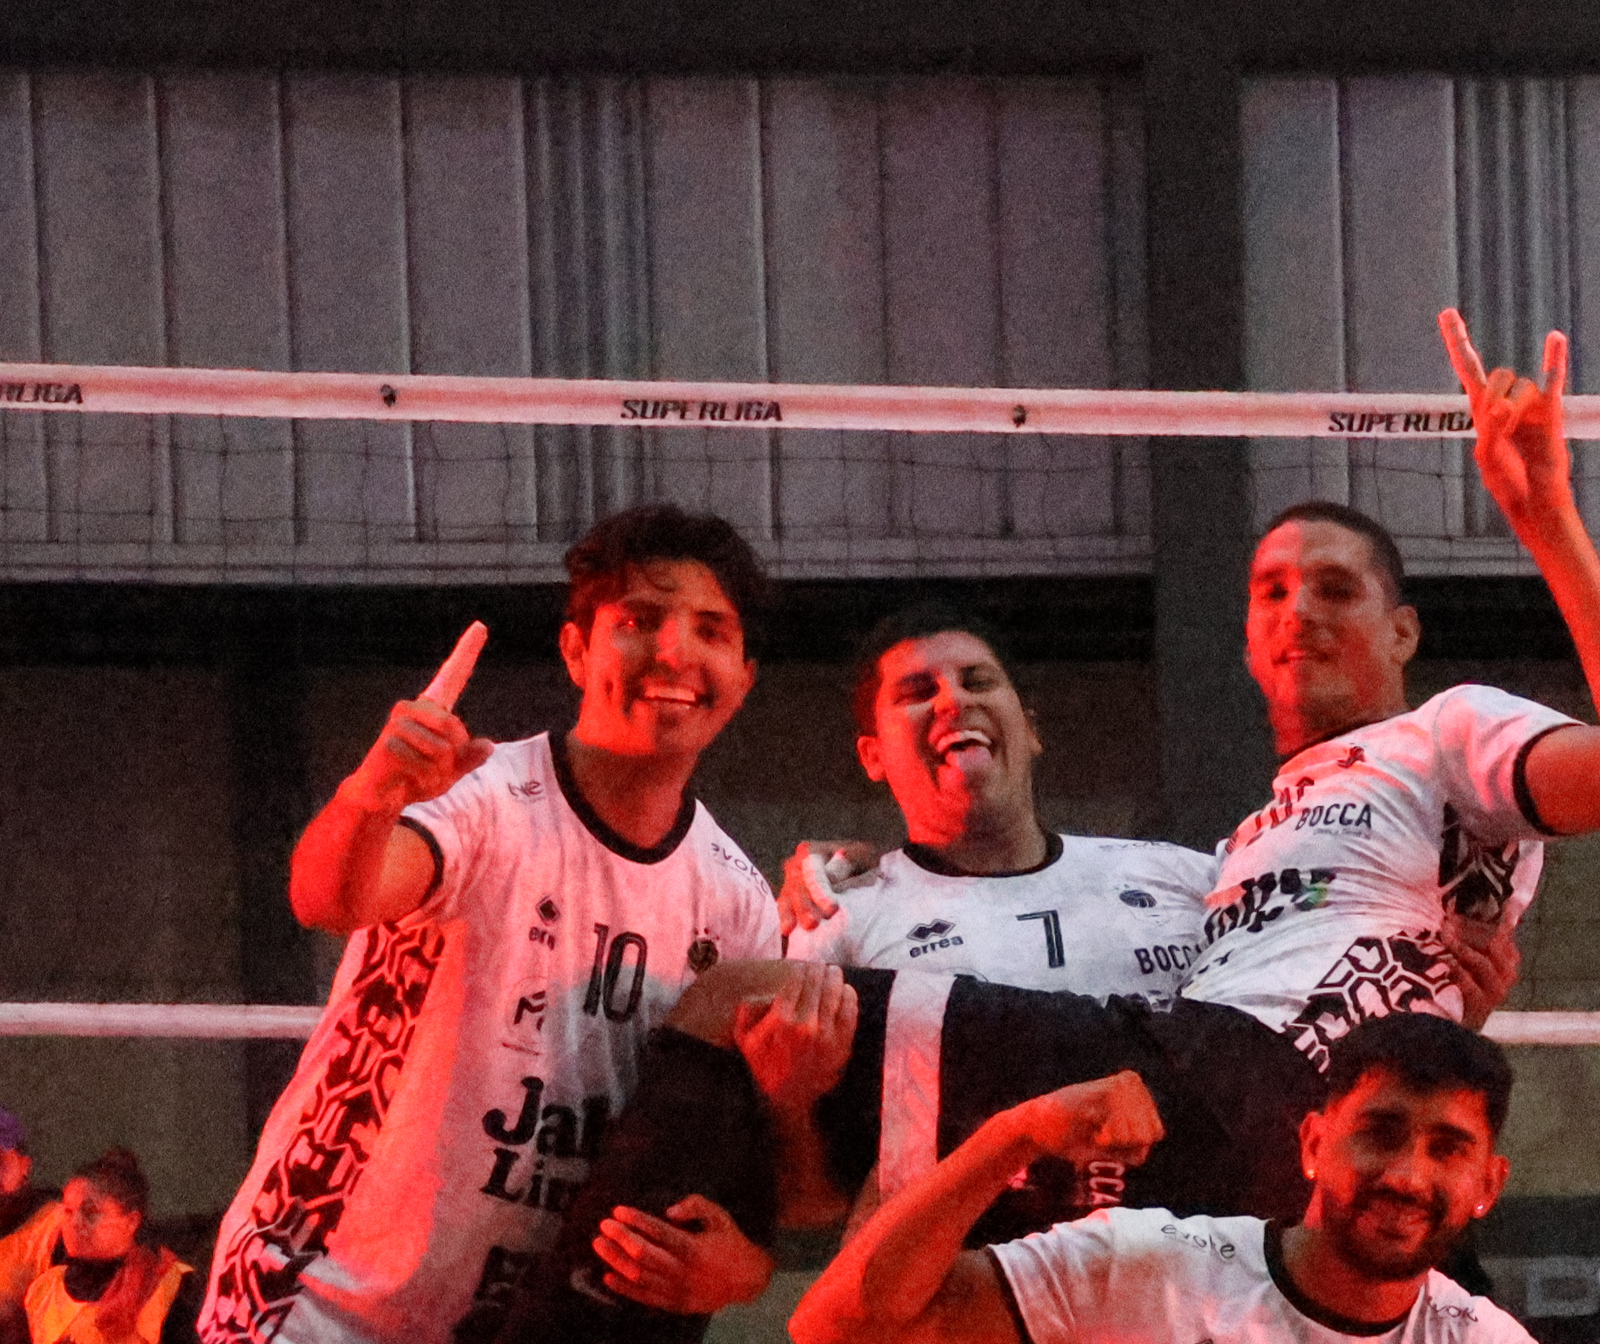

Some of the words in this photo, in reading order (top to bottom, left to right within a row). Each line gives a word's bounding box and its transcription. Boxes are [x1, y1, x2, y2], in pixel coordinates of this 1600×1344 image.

[621, 399, 783, 423] SUPERLIGA
[1296, 803, 1372, 830] BOCCA
[908, 933, 964, 960] errea
[1016, 909, 1067, 969] 7
[582, 923, 648, 1024] 10
[1089, 1161, 1126, 1206] CCA
